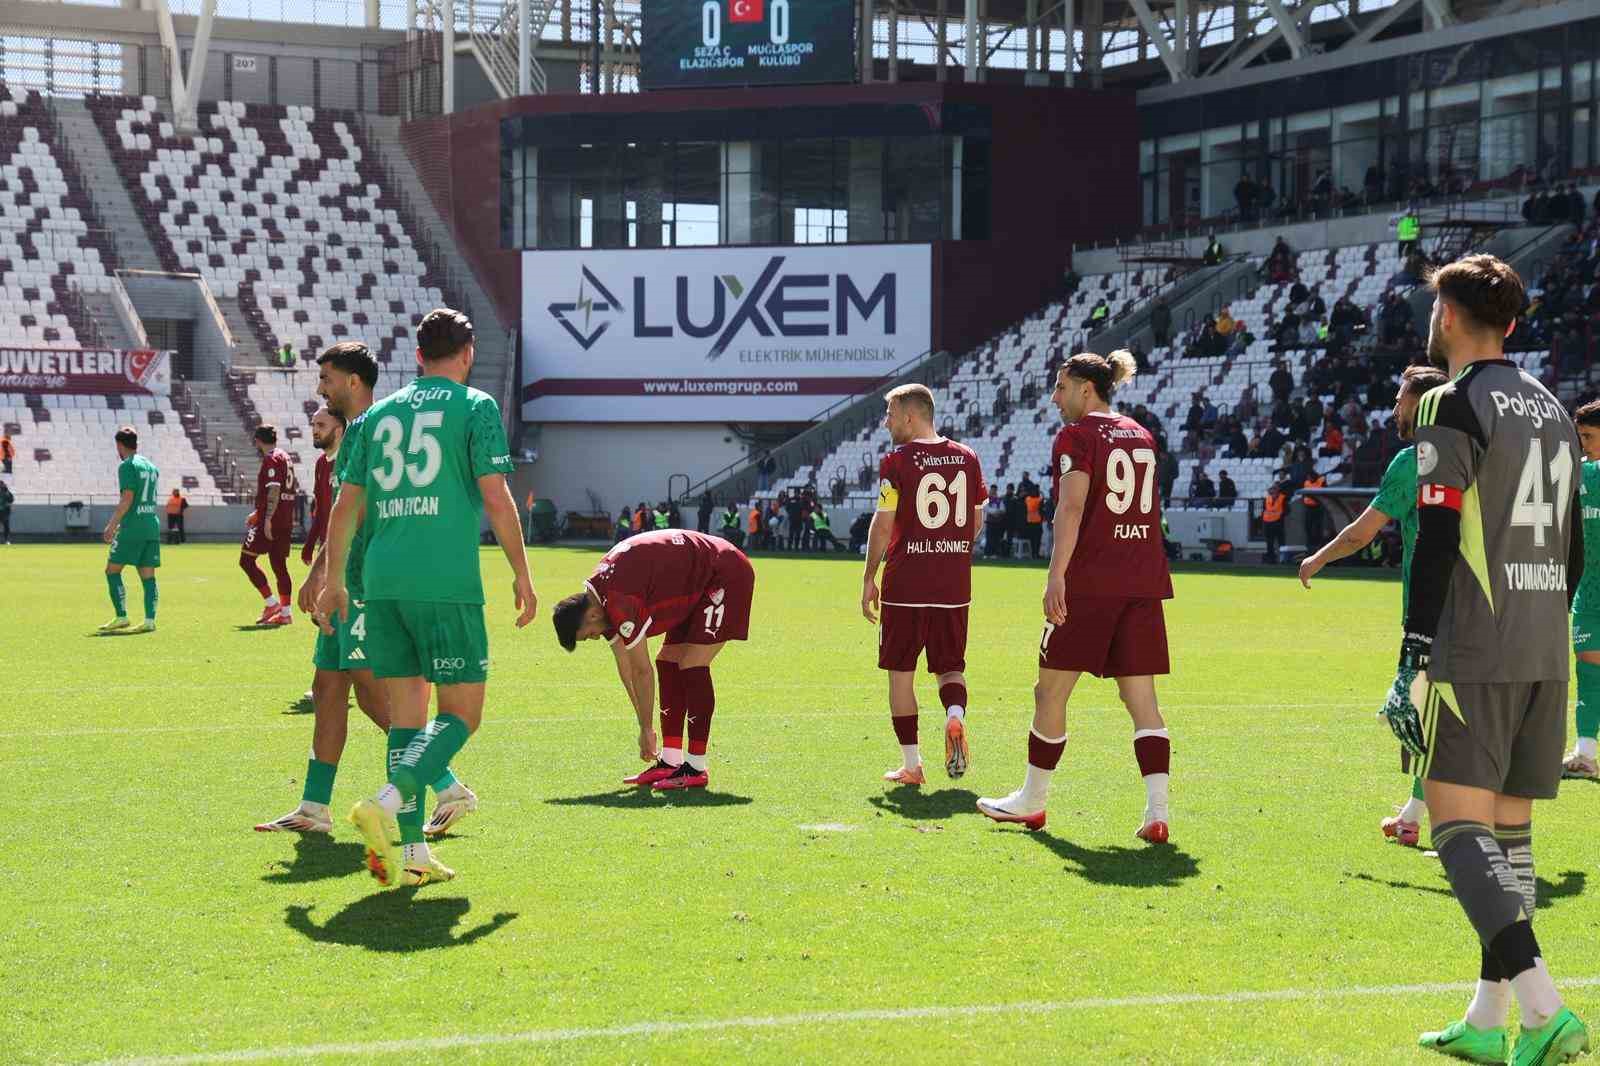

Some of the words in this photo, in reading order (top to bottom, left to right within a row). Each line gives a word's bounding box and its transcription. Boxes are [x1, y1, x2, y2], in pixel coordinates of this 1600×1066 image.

[702, 1, 720, 46] 0
[770, 0, 789, 43] 0
[694, 47, 720, 57] SEZA
[748, 43, 813, 55] MUĞLASPOR
[759, 54, 801, 66] KULÜBÜ
[633, 256, 896, 360] LUXEM
[739, 350, 801, 363] ELEKTRİK
[806, 347, 896, 362] MÜHENDİSLİK
[643, 380, 798, 395] www.luxemgrup.com
[1490, 391, 1561, 429] Polgün
[372, 410, 444, 491] 35
[1105, 448, 1156, 514] 97
[1510, 438, 1574, 547] 41
[916, 470, 967, 529] 61
[1113, 524, 1150, 539] FUAT
[907, 538, 934, 554] HALİL
[350, 613, 366, 640] 4
[703, 605, 725, 628] 11
